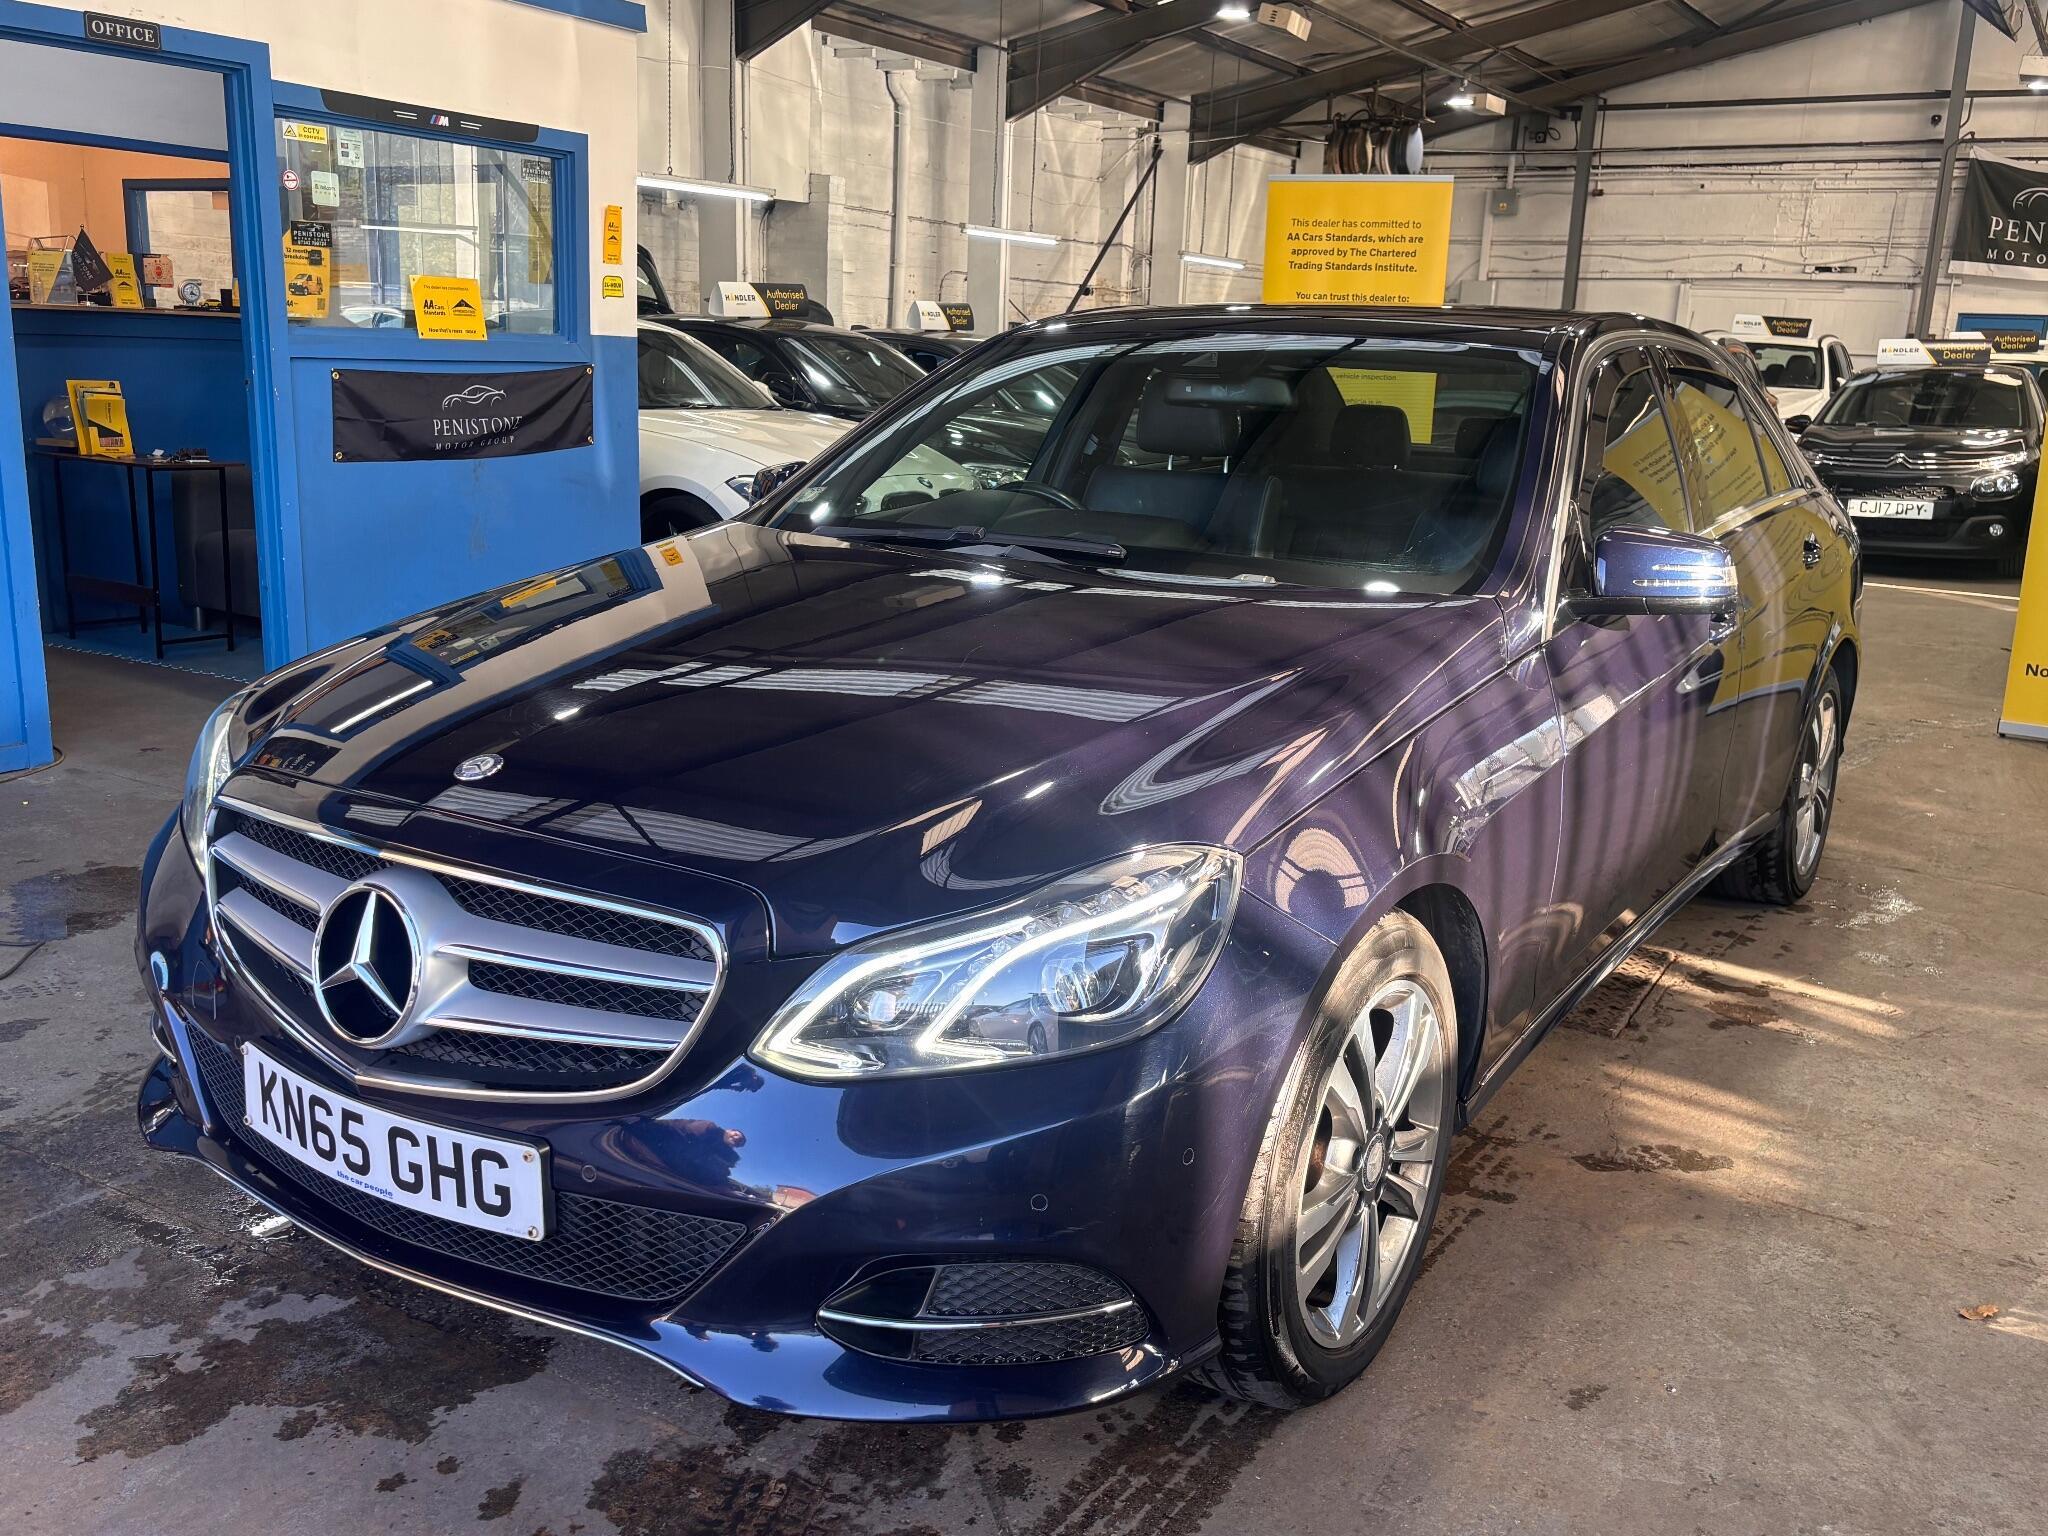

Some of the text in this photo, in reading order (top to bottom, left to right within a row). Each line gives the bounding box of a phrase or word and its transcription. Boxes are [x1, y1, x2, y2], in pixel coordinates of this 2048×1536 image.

[91, 20, 155, 42] OFFICE
[302, 126, 320, 135] CCTV
[1291, 218, 1422, 229] This dealer has committed to
[293, 230, 330, 239] PENISTONE
[1988, 216, 2047, 244] PEN
[1287, 233, 1424, 244] AA Cars Standards, which are
[1291, 247, 1417, 258] approved by The Chartered
[1289, 260, 1418, 273] Trading Standards Institute.
[766, 288, 804, 300] Authorised
[1296, 291, 1310, 300] You
[1330, 292, 1350, 301] trust
[1352, 293, 1367, 302] this
[1369, 293, 1396, 302] dealer
[1398, 295, 1410, 303] to:
[423, 299, 434, 309] AA
[774, 300, 799, 310] Dealer
[1772, 320, 1809, 328] Authorised
[1776, 326, 1800, 334] Dealer
[1994, 335, 2036, 343] Authorised
[2000, 342, 2027, 350] Dealer
[1943, 350, 1976, 360] Dealer
[434, 442, 475, 451] MOTOR
[1860, 501, 1925, 516] CJ17 DPY
[2025, 663, 2048, 678] No
[258, 1061, 512, 1218] KN65 GHG
[337, 1170, 349, 1181] the
[350, 1177, 364, 1186] car
[364, 1183, 393, 1197] people
